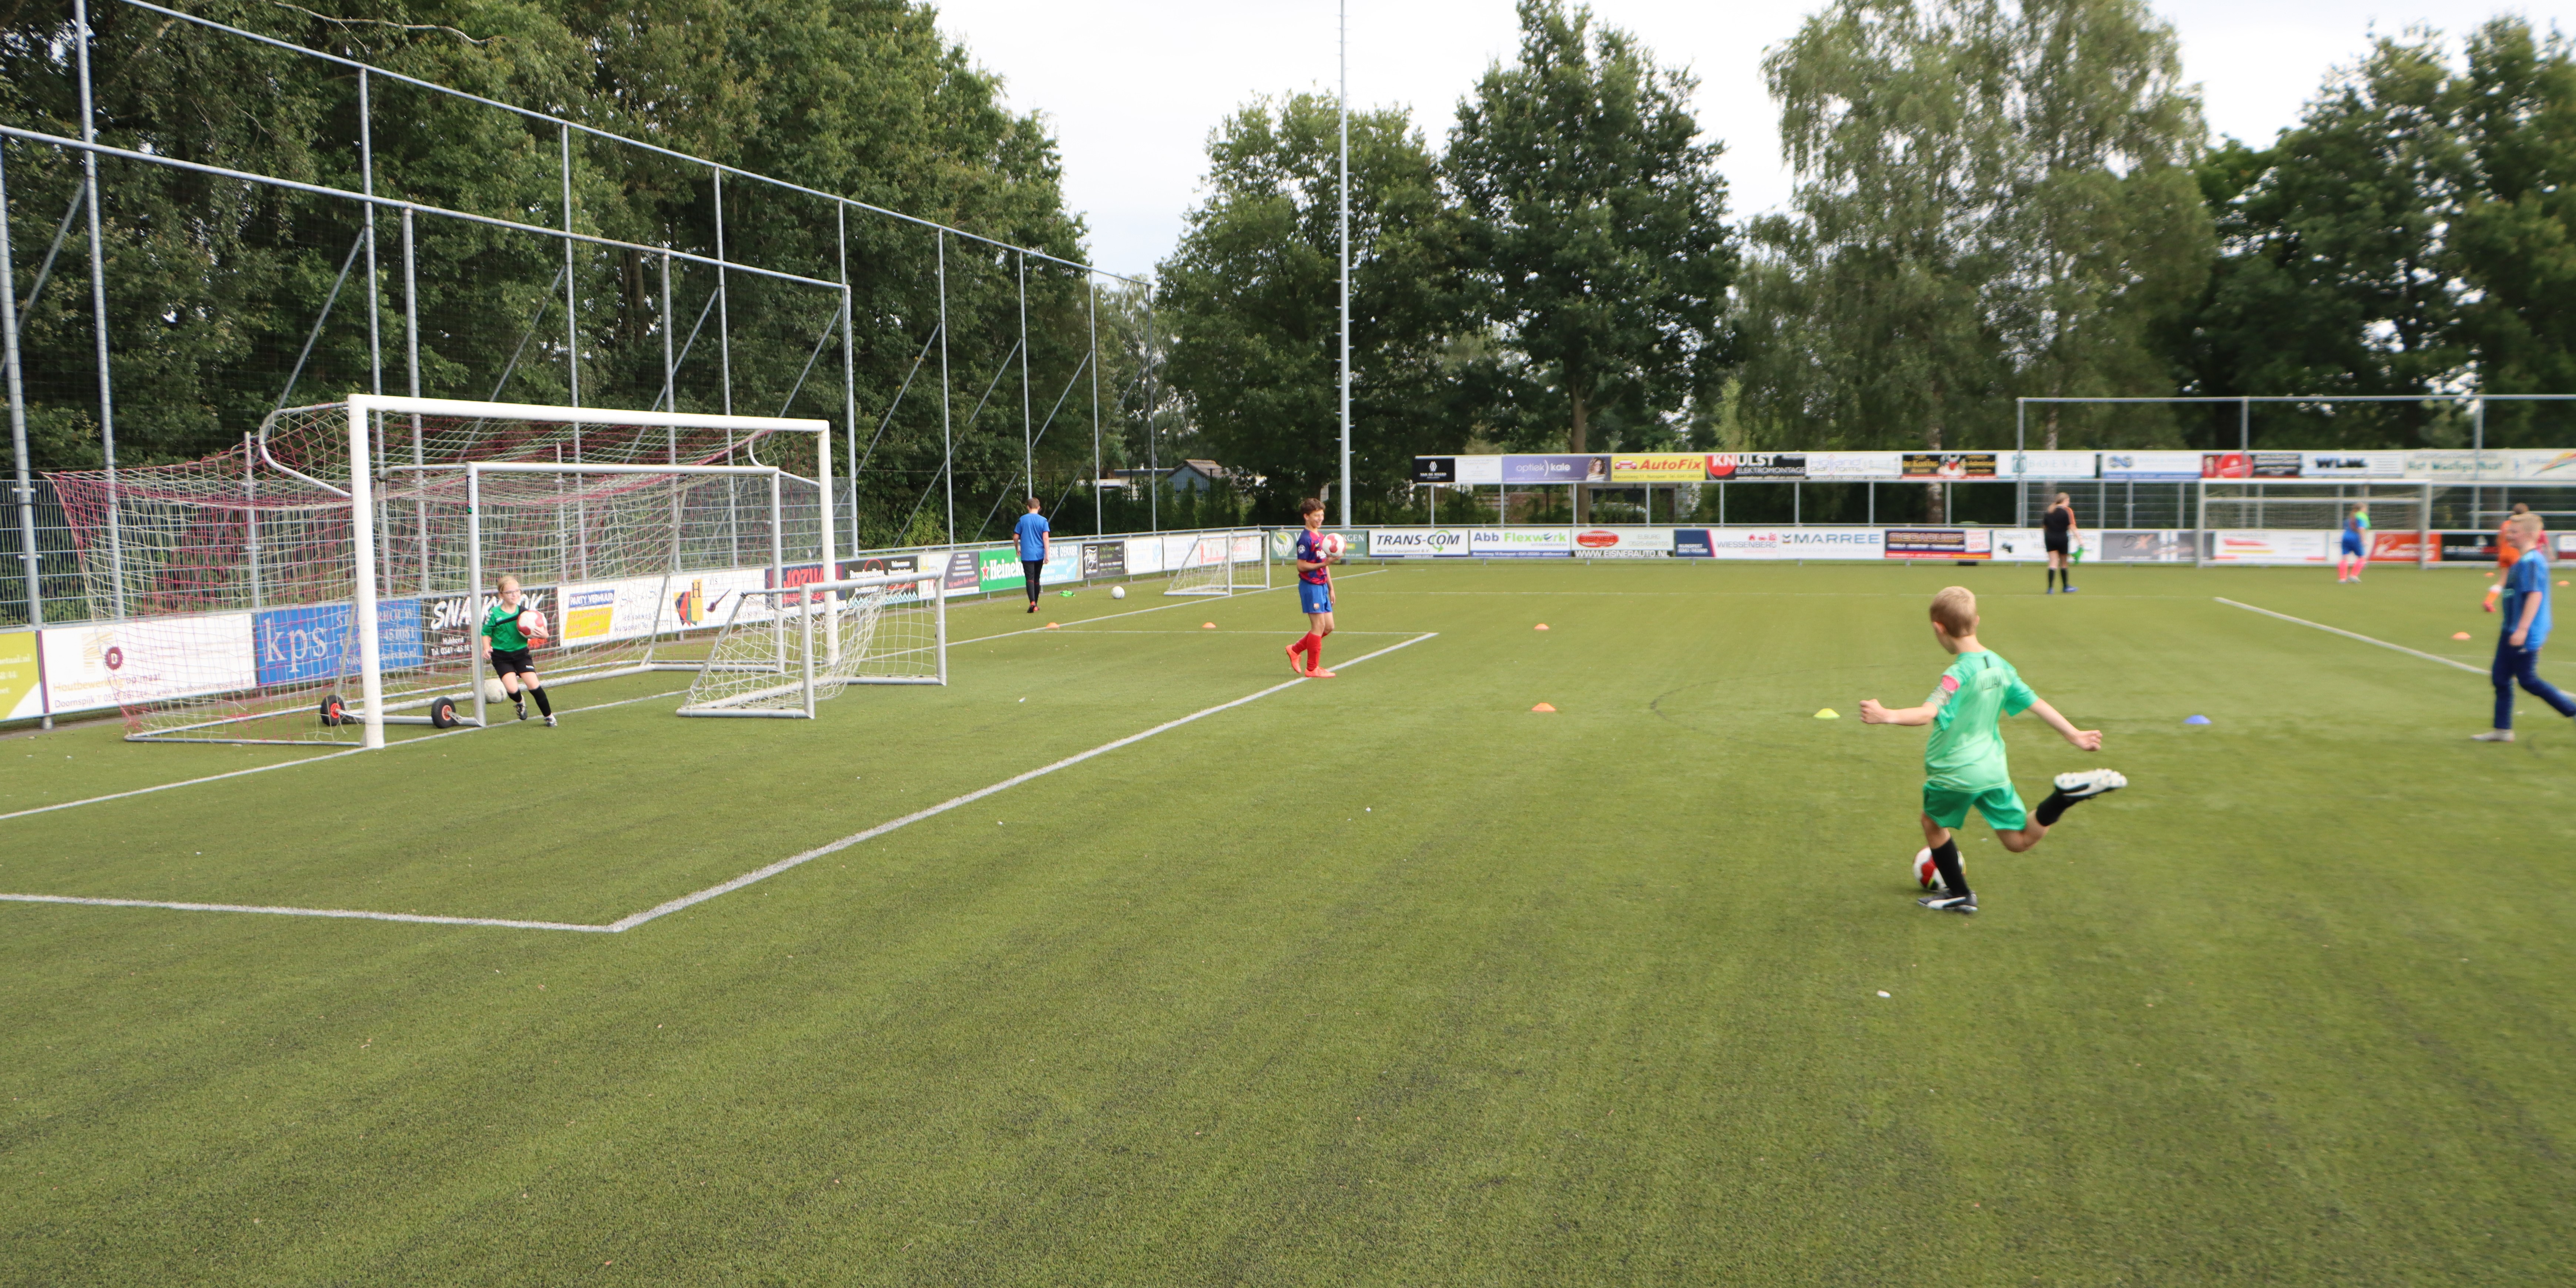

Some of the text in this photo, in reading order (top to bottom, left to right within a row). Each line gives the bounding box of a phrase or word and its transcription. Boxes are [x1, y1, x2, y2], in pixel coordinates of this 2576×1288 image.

[1639, 459, 1703, 470] AutoFix
[1712, 455, 1777, 467] KNULST
[1516, 463, 1571, 473] optiek kale
[1377, 534, 1460, 545] TRANS-COM
[1474, 532, 1499, 541] Abb
[1794, 533, 1881, 544] MARREE
[1049, 544, 1078, 557] ENÉ DEKKER
[850, 568, 885, 579] Strandpaviljoen
[989, 557, 1026, 580] Heineke
[692, 581, 701, 598] H
[570, 592, 614, 606] PARTY VERHUUR
[264, 617, 327, 672] kps
[443, 636, 464, 645] Hulshorst
[0, 653, 30, 665] etaal.nl
[53, 673, 161, 693] Houtbewerking op maat
[55, 695, 95, 708] Doornspijk
